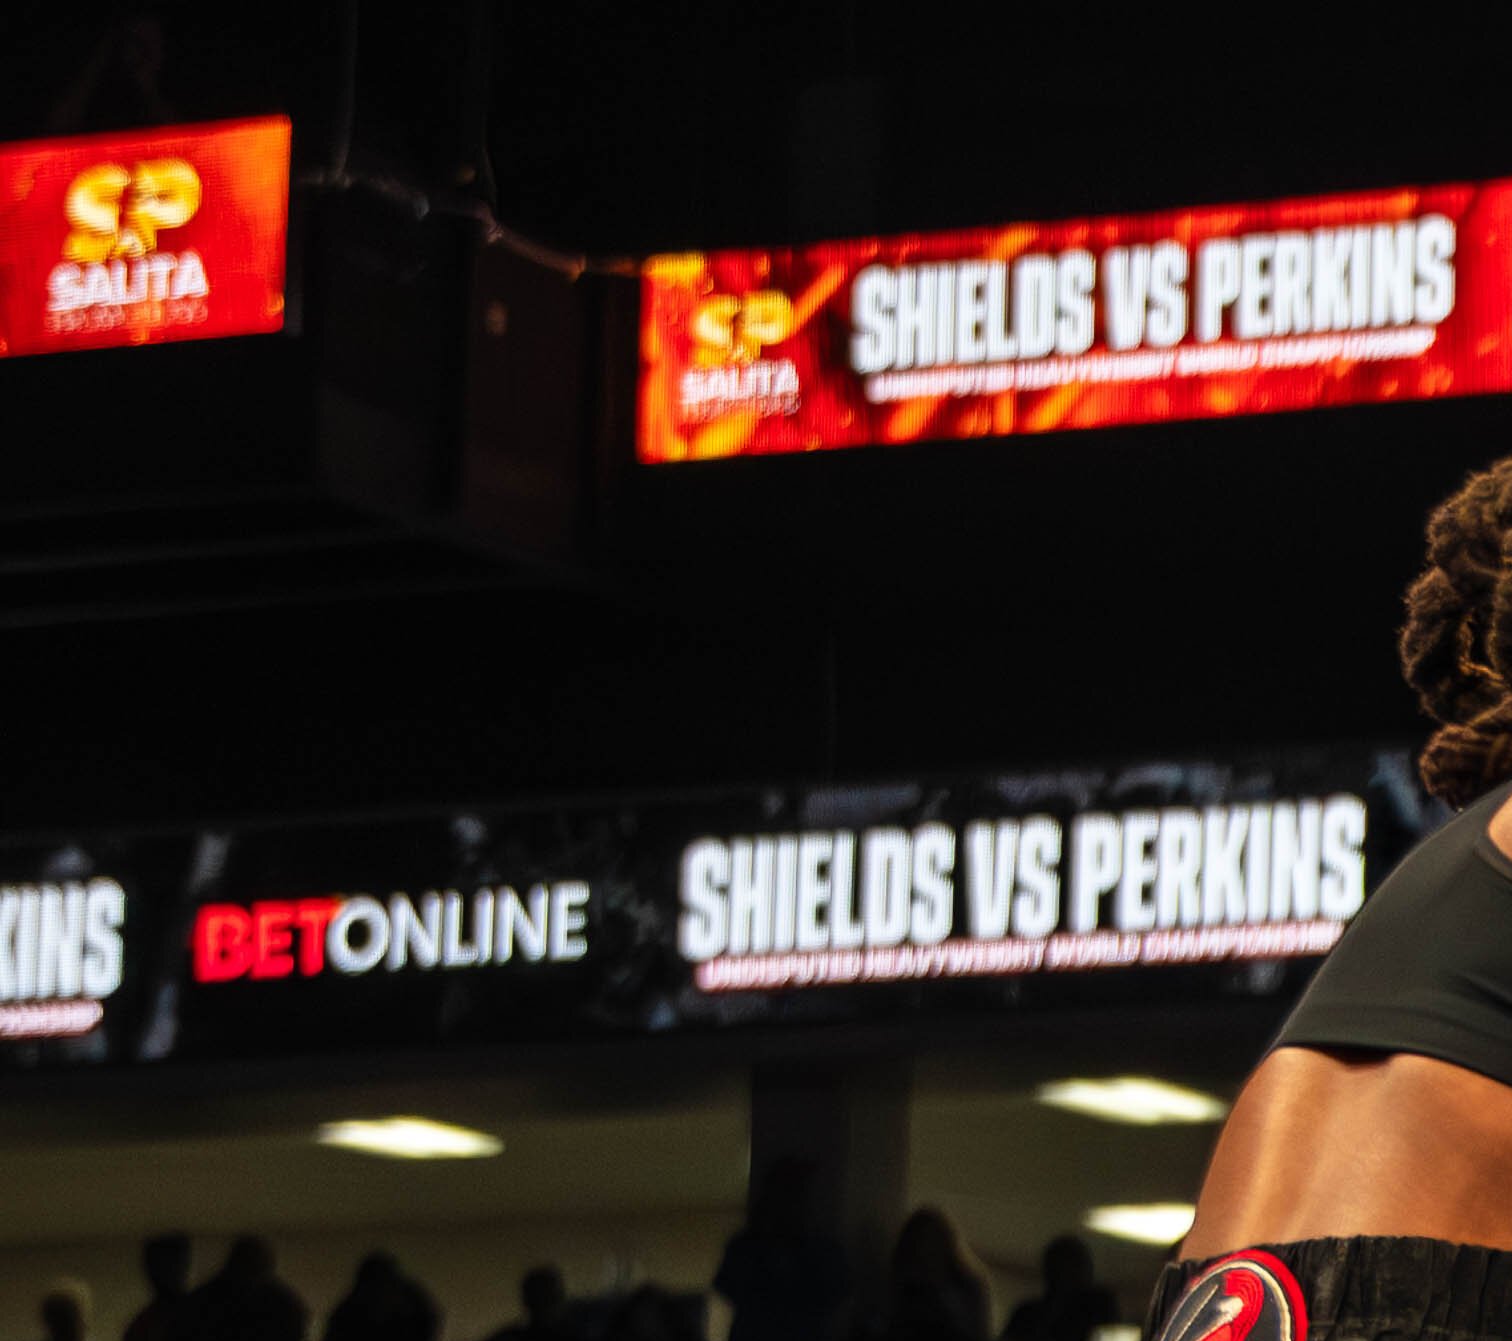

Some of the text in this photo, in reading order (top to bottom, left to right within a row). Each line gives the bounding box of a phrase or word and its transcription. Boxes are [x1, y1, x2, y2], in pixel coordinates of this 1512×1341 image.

[850, 247, 1098, 377] SHIELDS
[1101, 239, 1191, 352] VS
[1195, 213, 1457, 344] PERKINS
[191, 879, 591, 984] BETONLINE
[678, 793, 1368, 962] SHIELDS VS PERKINS
